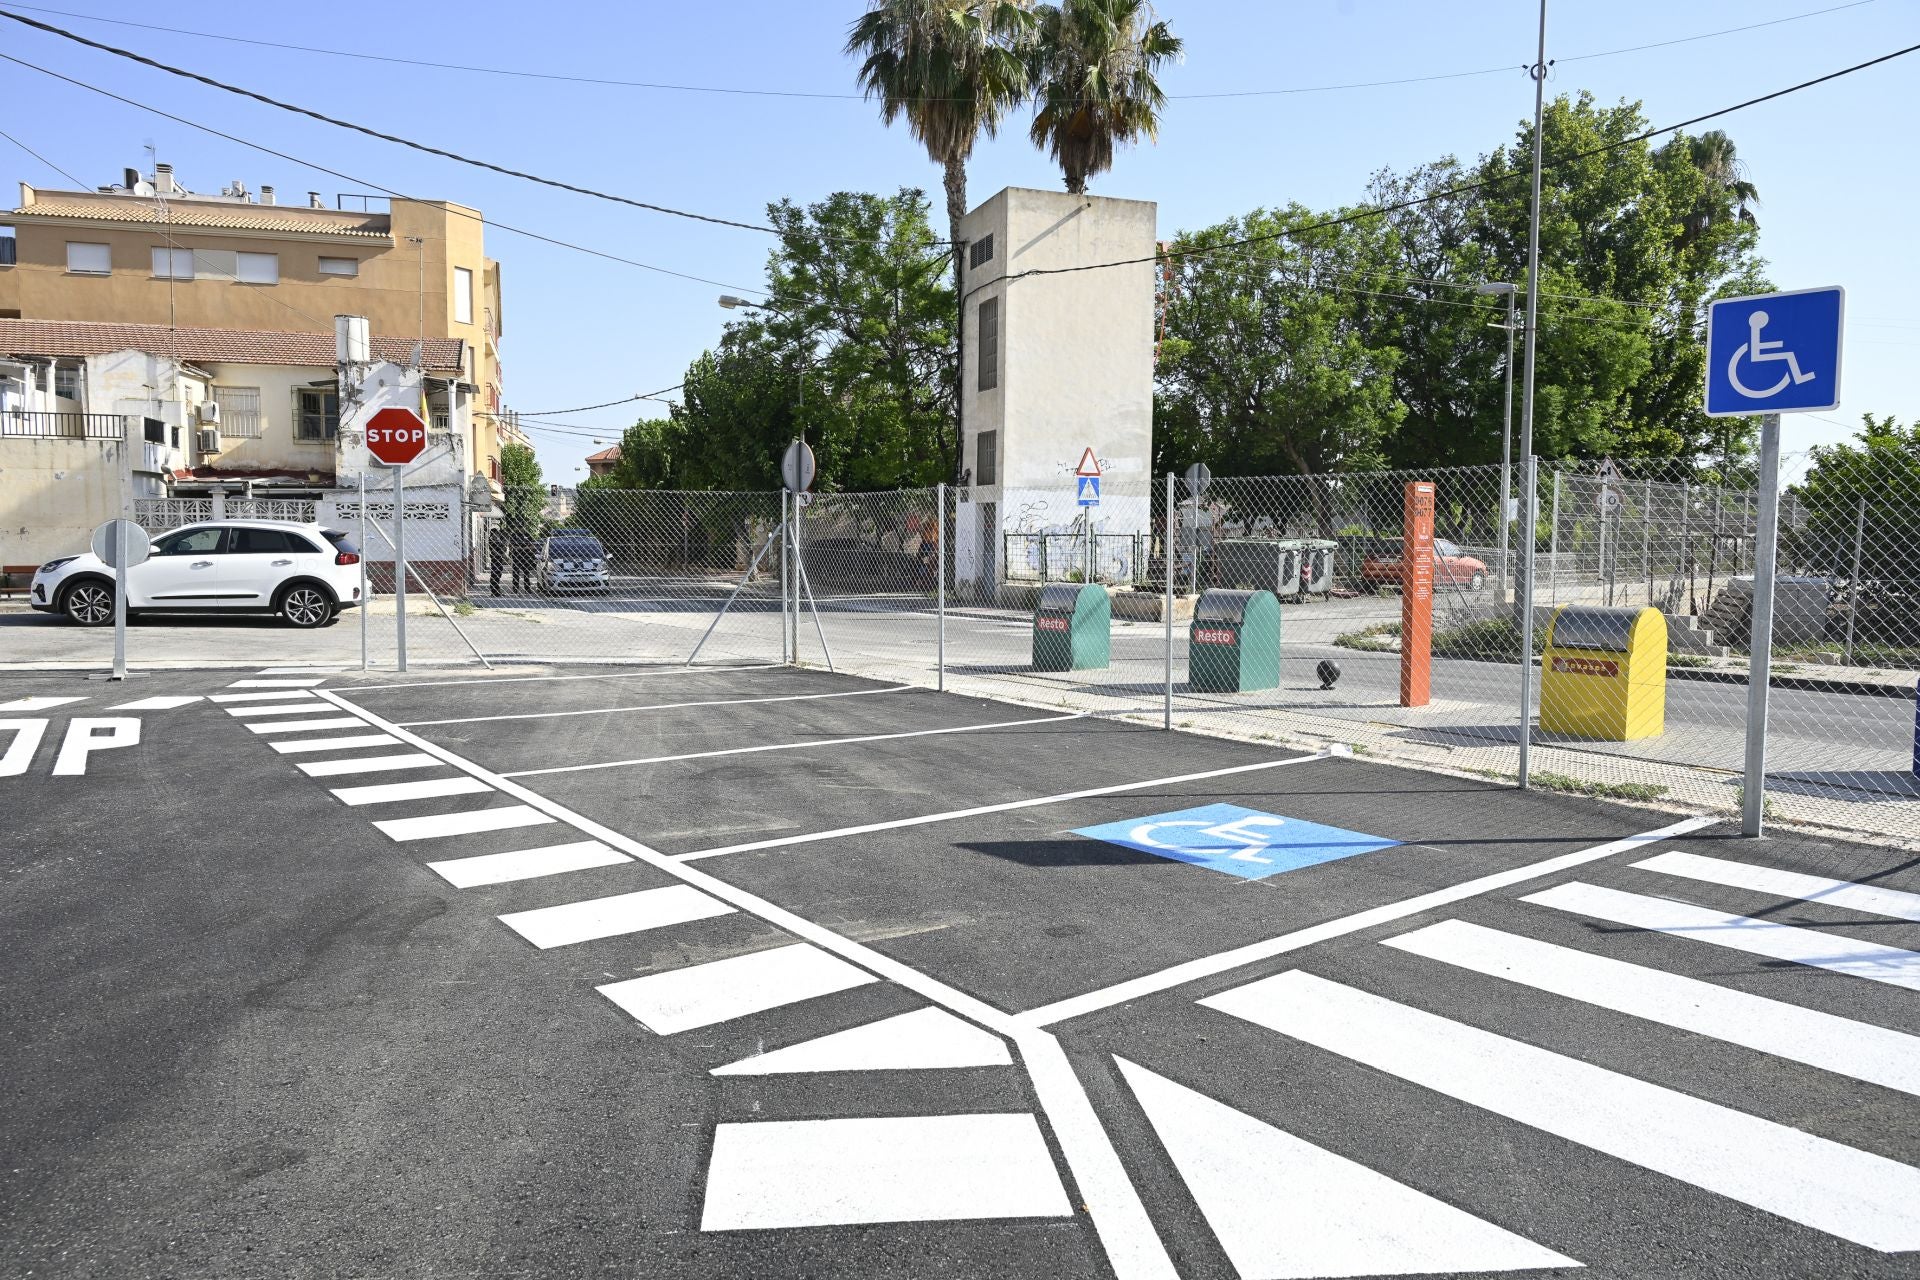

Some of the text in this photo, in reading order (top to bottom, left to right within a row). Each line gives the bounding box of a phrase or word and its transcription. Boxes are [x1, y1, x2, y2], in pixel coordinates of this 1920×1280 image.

[367, 429, 423, 442] STOP
[1040, 618, 1065, 629] Resto
[1197, 630, 1231, 642] Resto
